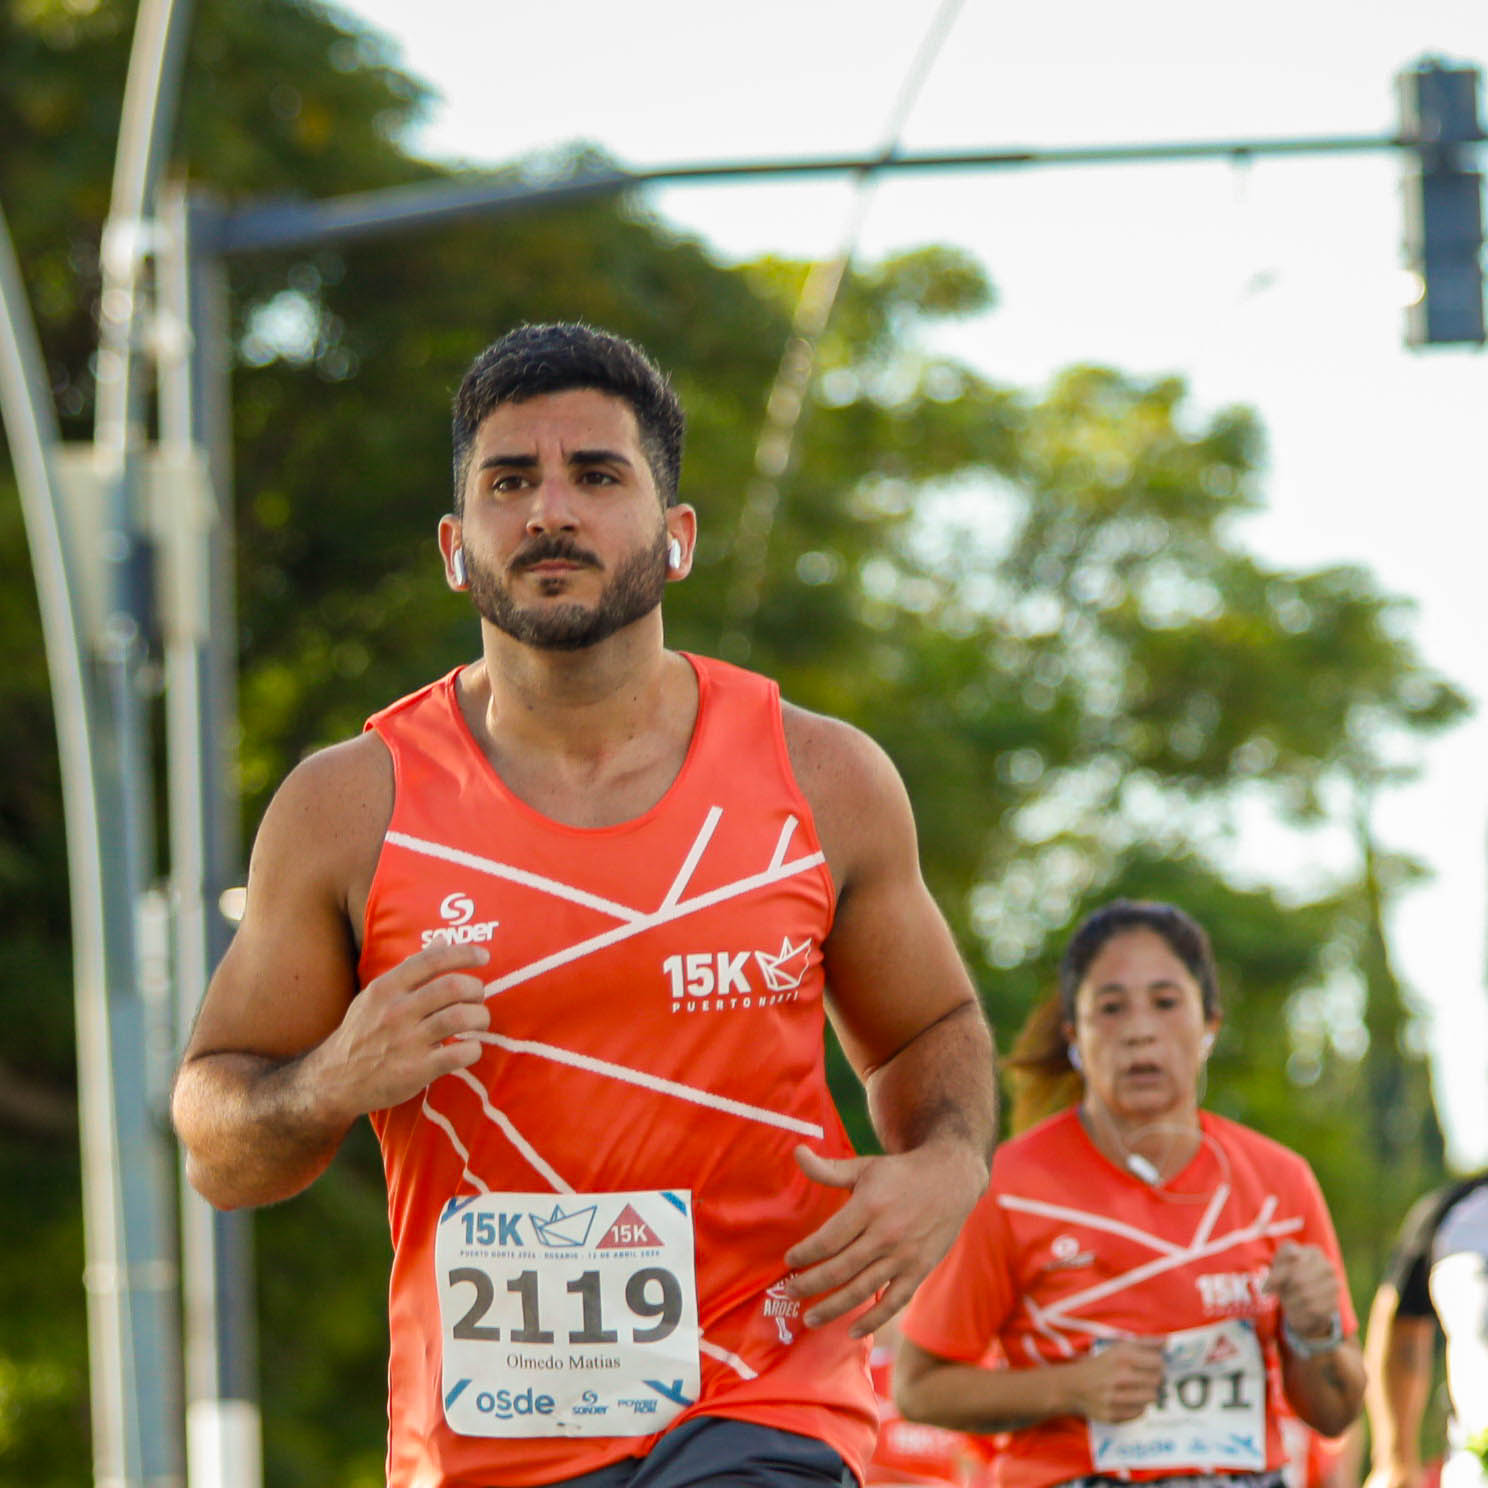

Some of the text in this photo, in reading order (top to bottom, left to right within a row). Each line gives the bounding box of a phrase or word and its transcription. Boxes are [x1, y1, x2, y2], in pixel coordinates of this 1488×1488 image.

[663, 951, 752, 998] 15K
[672, 997, 751, 1013] PUERTO
[461, 1212, 524, 1246] 15K
[611, 1223, 647, 1243] 15K
[448, 1267, 683, 1344] 2119
[506, 1353, 621, 1370] Olmedo Matias
[475, 1387, 555, 1419] osde
